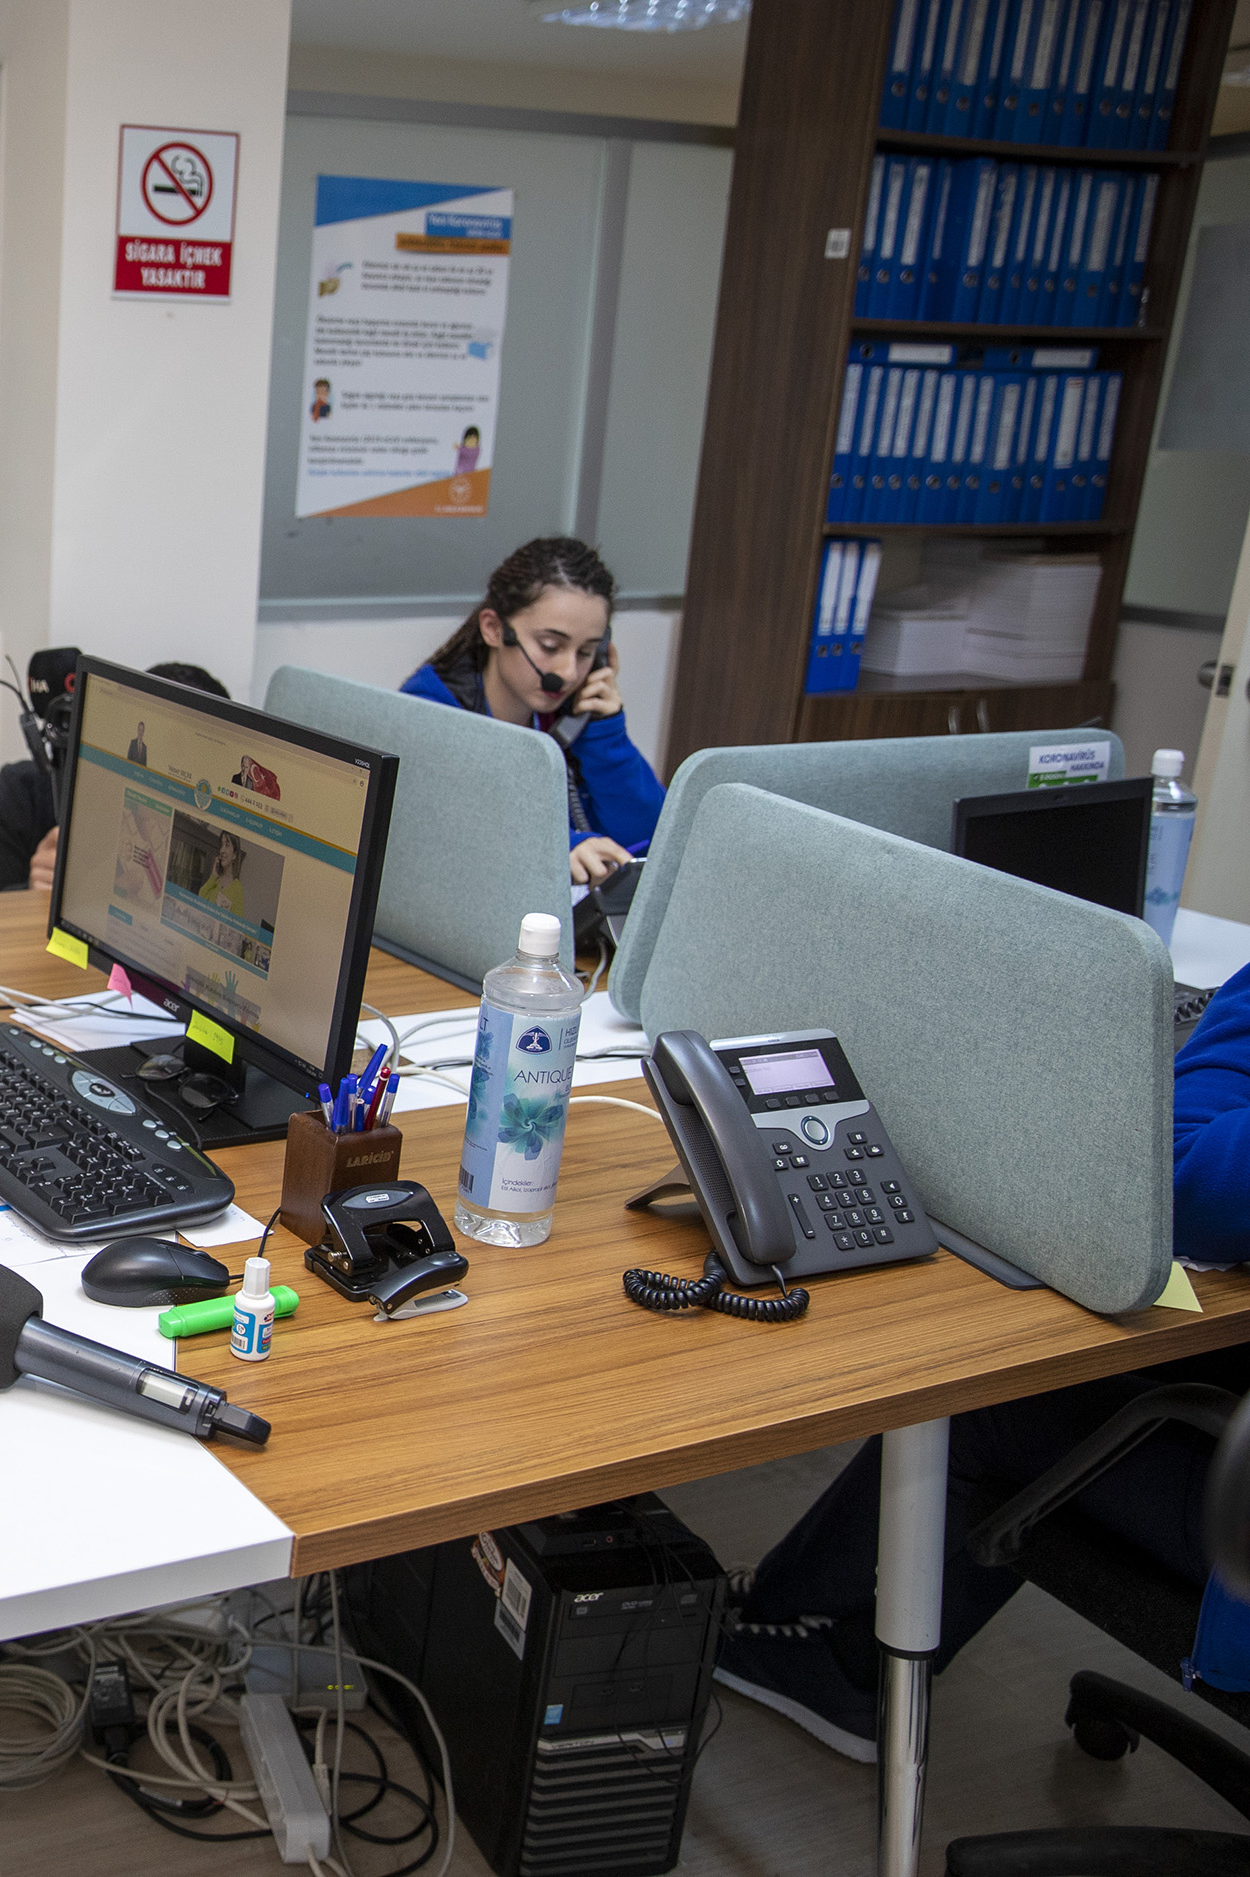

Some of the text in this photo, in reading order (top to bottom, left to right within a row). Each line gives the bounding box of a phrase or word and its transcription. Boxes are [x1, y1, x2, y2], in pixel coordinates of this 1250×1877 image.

[125, 239, 222, 268] SİGARA İÇMEK
[141, 266, 206, 289] YASAKTIR
[163, 998, 180, 1013] acer
[574, 1592, 604, 1603] acer
